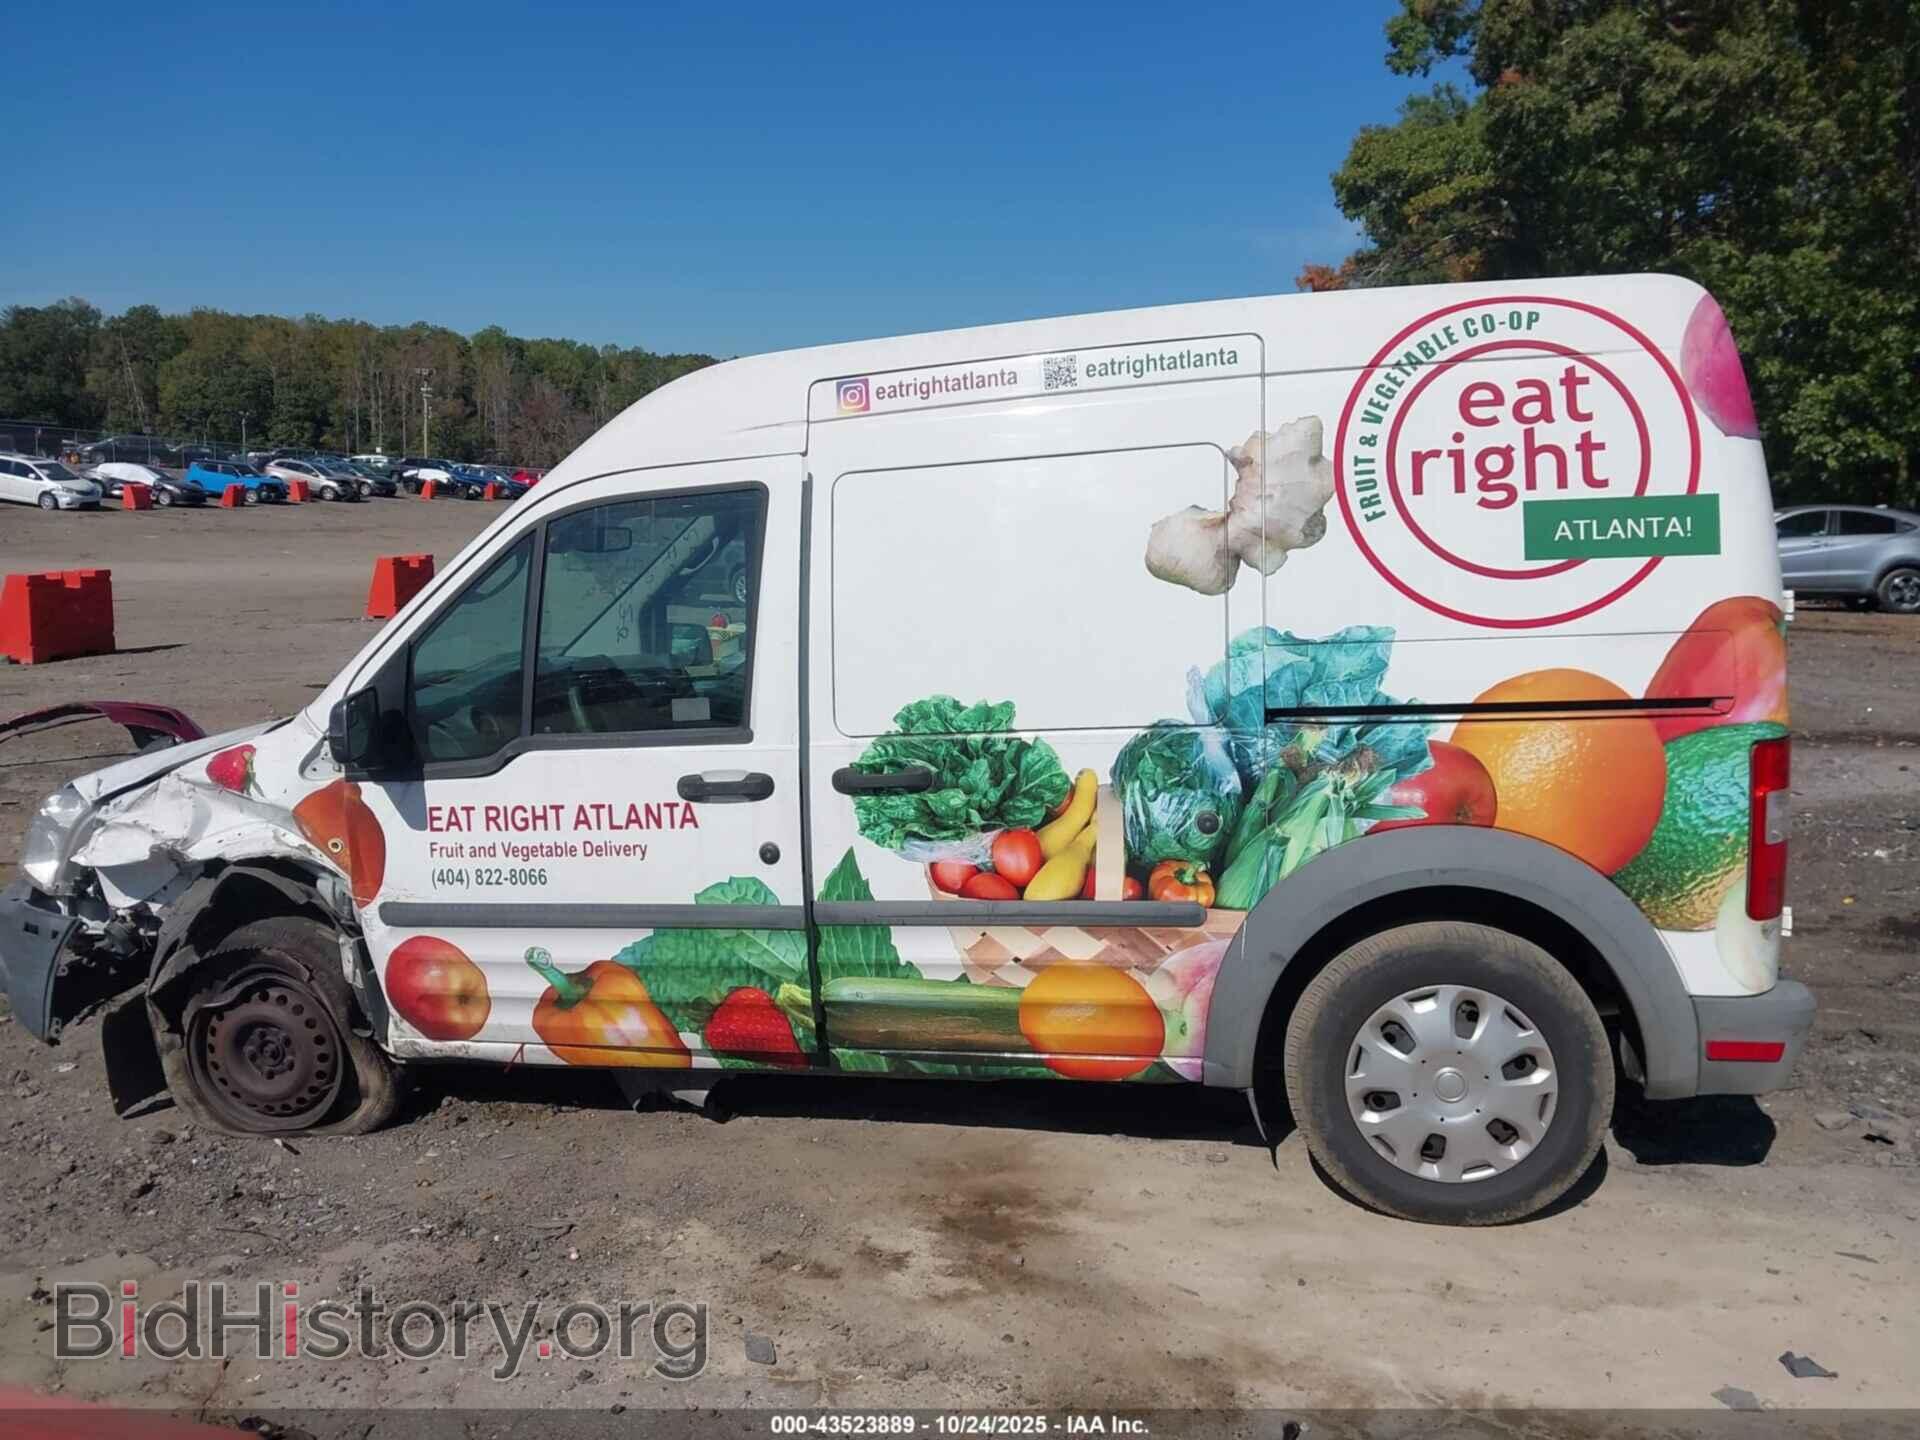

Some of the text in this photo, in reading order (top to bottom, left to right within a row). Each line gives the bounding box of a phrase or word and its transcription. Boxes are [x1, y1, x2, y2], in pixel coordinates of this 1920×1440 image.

[1085, 346, 1239, 380] eatrightatlanta
[875, 368, 1018, 402] eatrightatlanta
[1458, 365, 1593, 428] eat
[1354, 310, 1540, 522] FRUIT & VEGETABLE CO-OP
[1411, 427, 1610, 509] right
[1554, 516, 1693, 542] ATLANTA!
[428, 802, 699, 832] EAT RIGHT ATLANTA
[429, 840, 648, 861] Fruit and Vegetable Delivery
[431, 867, 548, 889] (404) 822-8066
